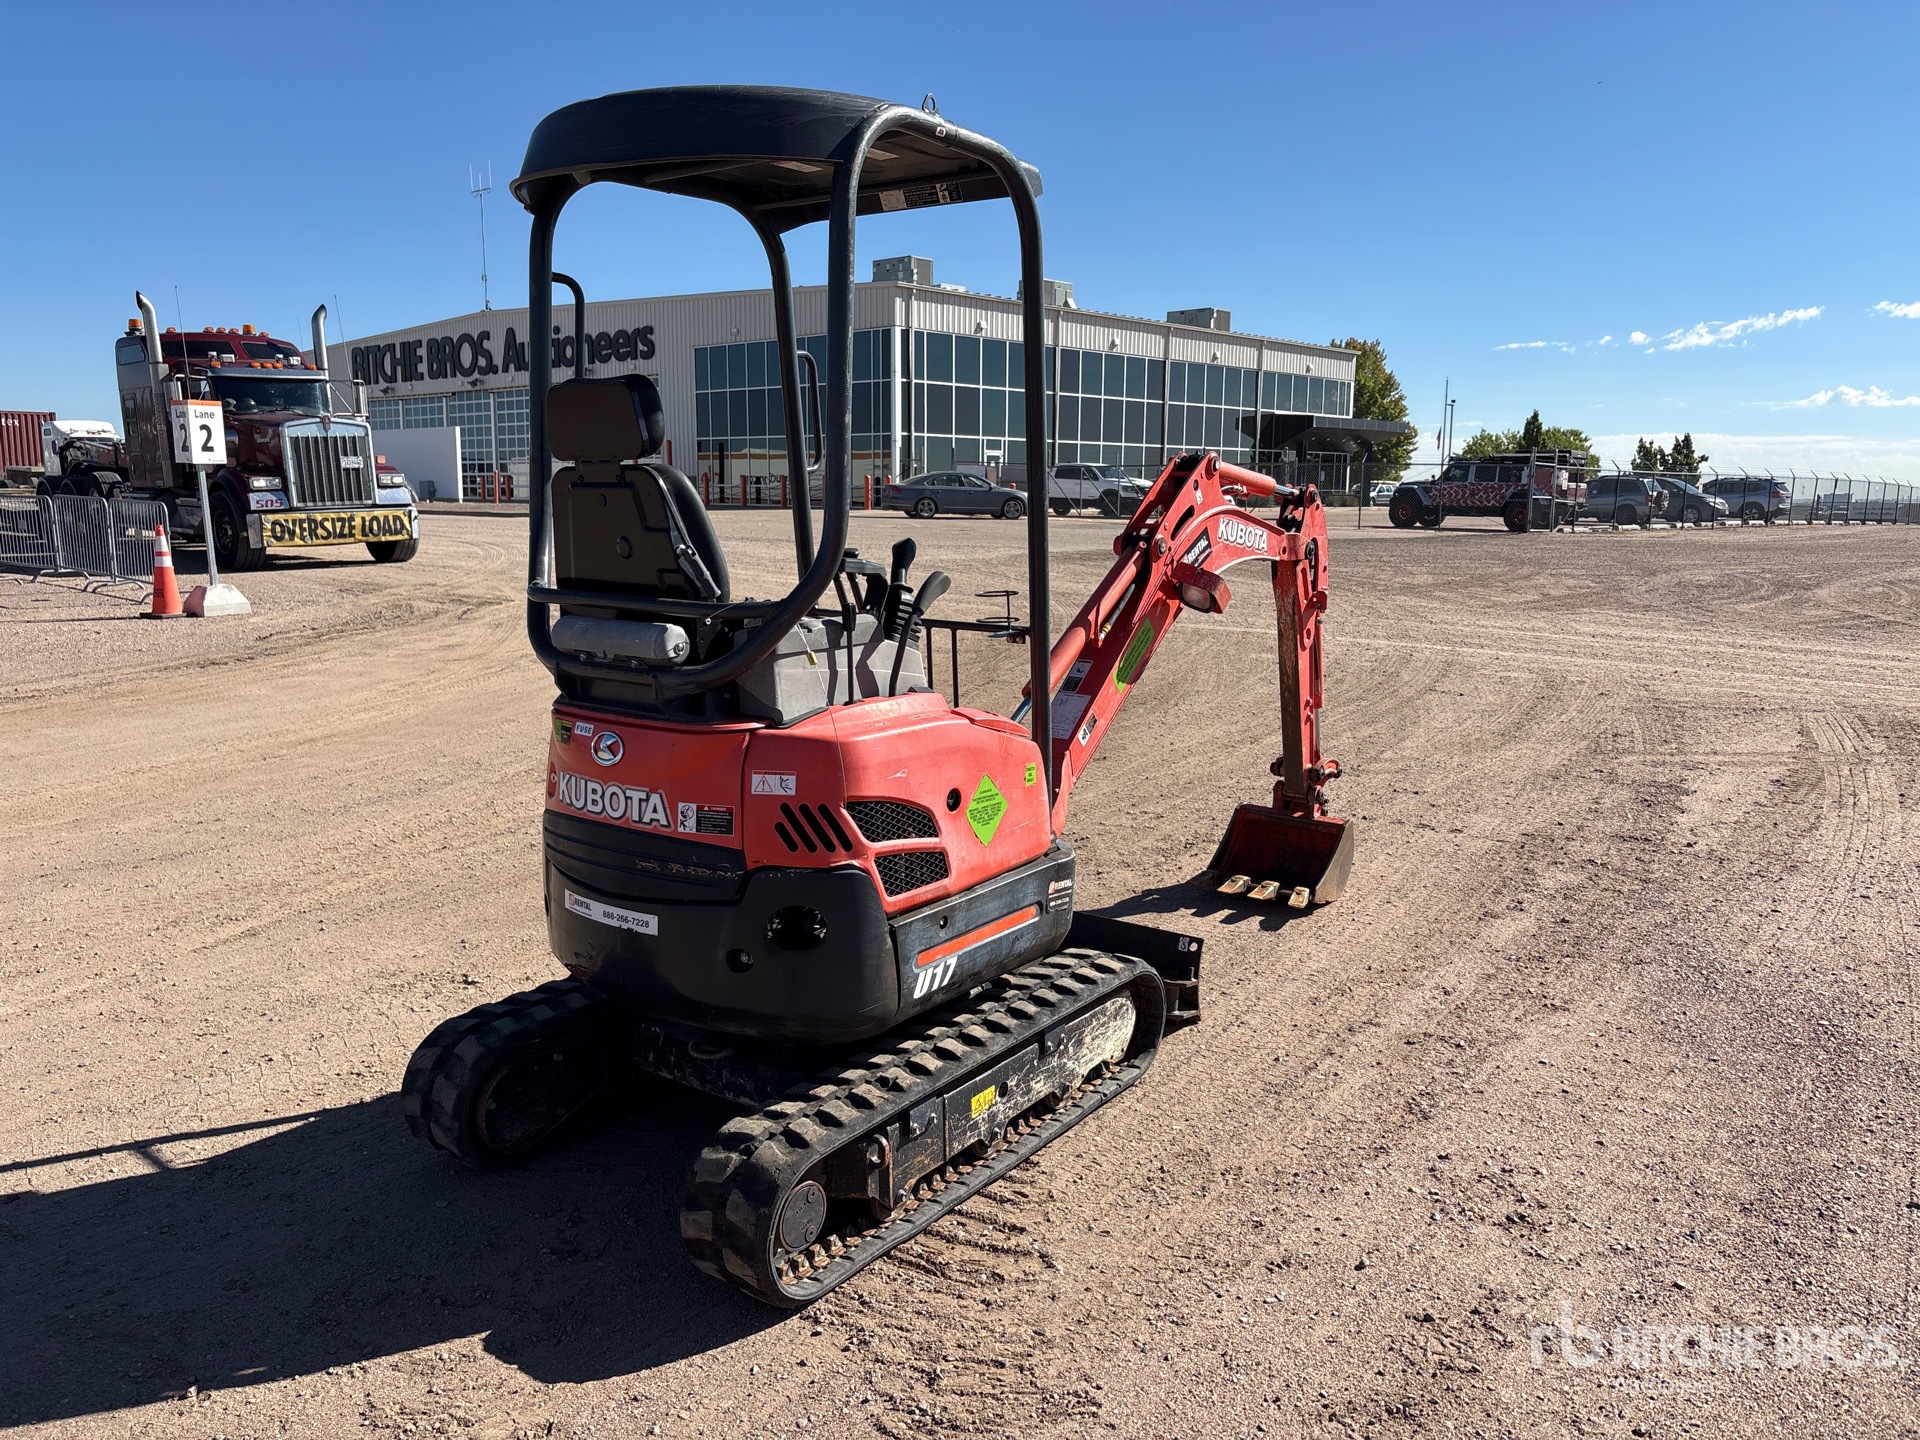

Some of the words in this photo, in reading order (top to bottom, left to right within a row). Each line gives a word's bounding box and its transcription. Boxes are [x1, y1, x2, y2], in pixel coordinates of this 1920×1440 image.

[352, 338, 425, 386] RITCHIE
[427, 330, 499, 380] BROS.
[194, 409, 215, 419] Lane
[179, 423, 190, 452] 2
[199, 424, 215, 452] 2
[271, 517, 356, 542] OVERSIZE
[361, 515, 405, 538] LOAD
[1218, 518, 1267, 553] KUBOTA
[1187, 536, 1209, 563] RENTAL
[576, 724, 592, 735] FUSE
[559, 771, 672, 828] KUBOTA
[1055, 879, 1072, 890] RENTAL
[574, 898, 592, 912] RENTAL
[602, 909, 650, 928] 888-266-7228
[913, 956, 957, 999] U17
